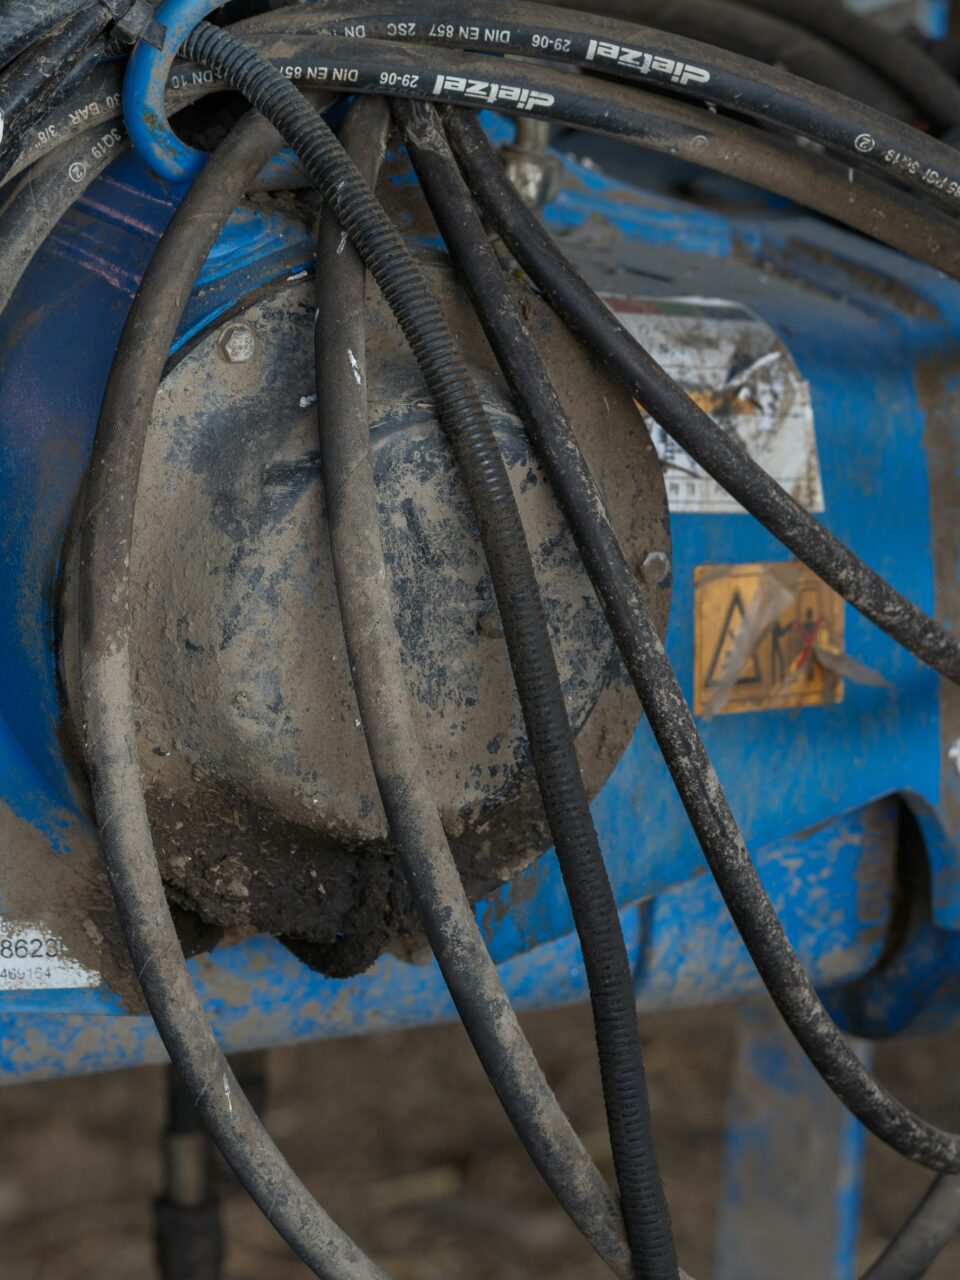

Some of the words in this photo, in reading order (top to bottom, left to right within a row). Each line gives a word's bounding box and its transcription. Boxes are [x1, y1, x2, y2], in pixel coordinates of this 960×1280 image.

[344, 25, 366, 38] DN
[387, 23, 416, 36] 2SC
[429, 24, 454, 38] 857
[459, 26, 479, 40] EN
[484, 28, 510, 43] DIN
[531, 34, 571, 52] 29-06
[585, 39, 710, 85] dietzel
[192, 70, 213, 85] DN
[306, 66, 328, 80] EN
[332, 68, 359, 82] DIN
[380, 71, 419, 87] 29-06
[172, 74, 187, 89] 10
[433, 74, 555, 110] dietzel
[69, 102, 100, 124] BAR
[92, 128, 121, 158] 3Q19
